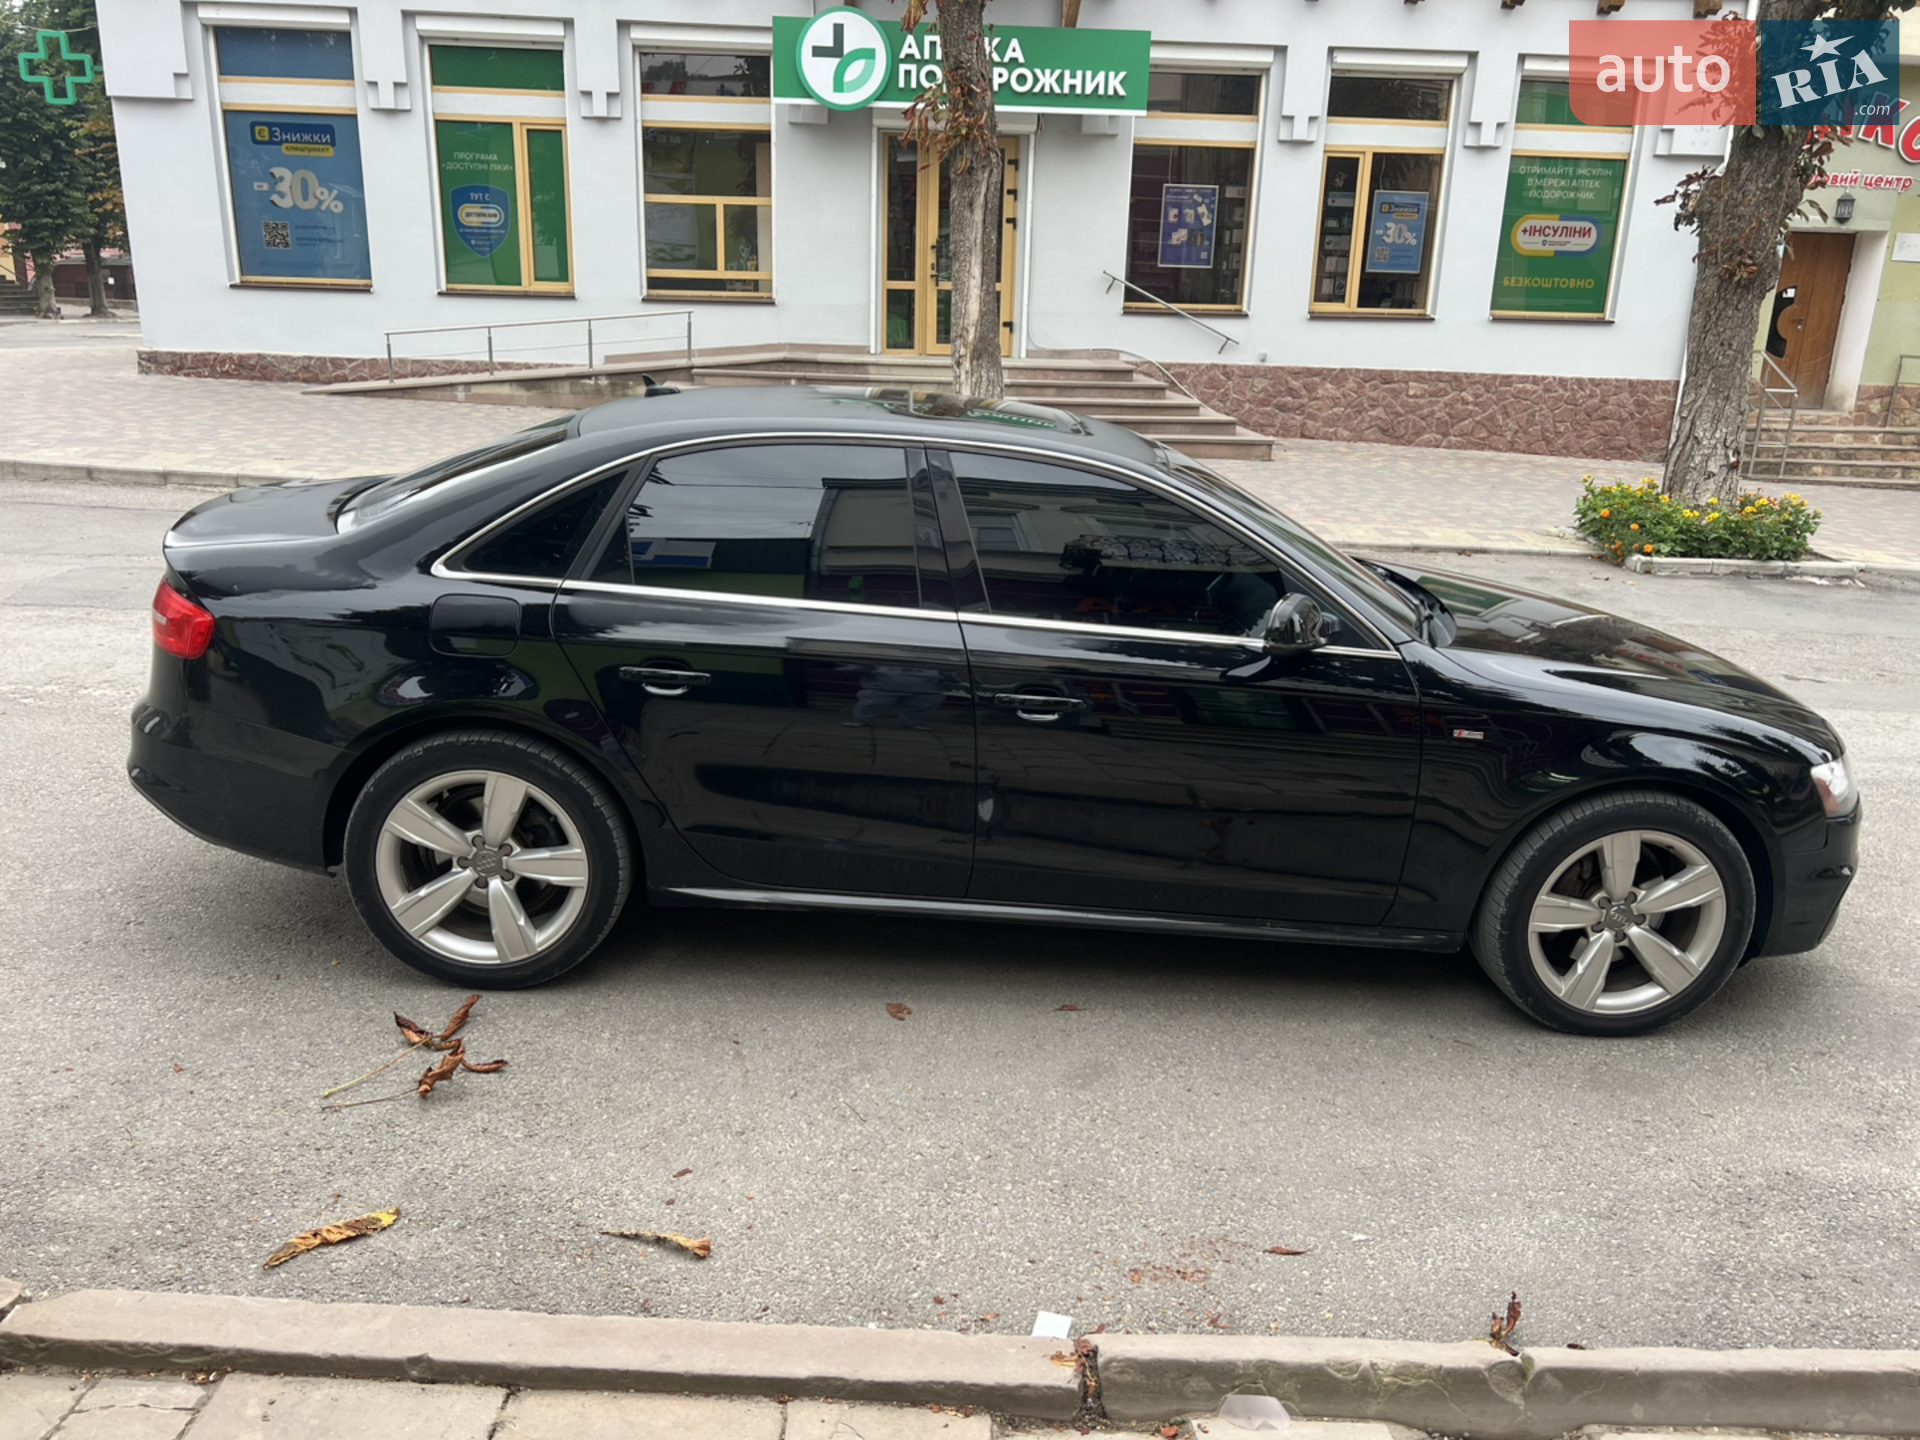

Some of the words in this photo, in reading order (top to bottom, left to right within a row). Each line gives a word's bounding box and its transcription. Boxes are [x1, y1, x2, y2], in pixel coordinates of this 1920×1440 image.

[898, 34, 1025, 63] АПКА
[898, 64, 1127, 96] ПОРОЖНИК
[271, 127, 331, 143] Знижки
[453, 152, 498, 161] ПРОГРАМА
[1519, 165, 1574, 176] ОТРИМАЙТЕ
[1575, 167, 1612, 177] ІНСУЛІН
[253, 166, 344, 213] -30%
[1535, 178, 1570, 187] МЕРЕЖІ
[1571, 179, 1601, 188] АПТЕК
[1861, 173, 1913, 192] центр
[1528, 189, 1595, 200] ПОДОРОЖНИК
[1375, 222, 1417, 245] -30%
[1521, 225, 1592, 238] +ІНСУЛІНИ
[1503, 277, 1595, 289] БЕЗКОШТОВНО
